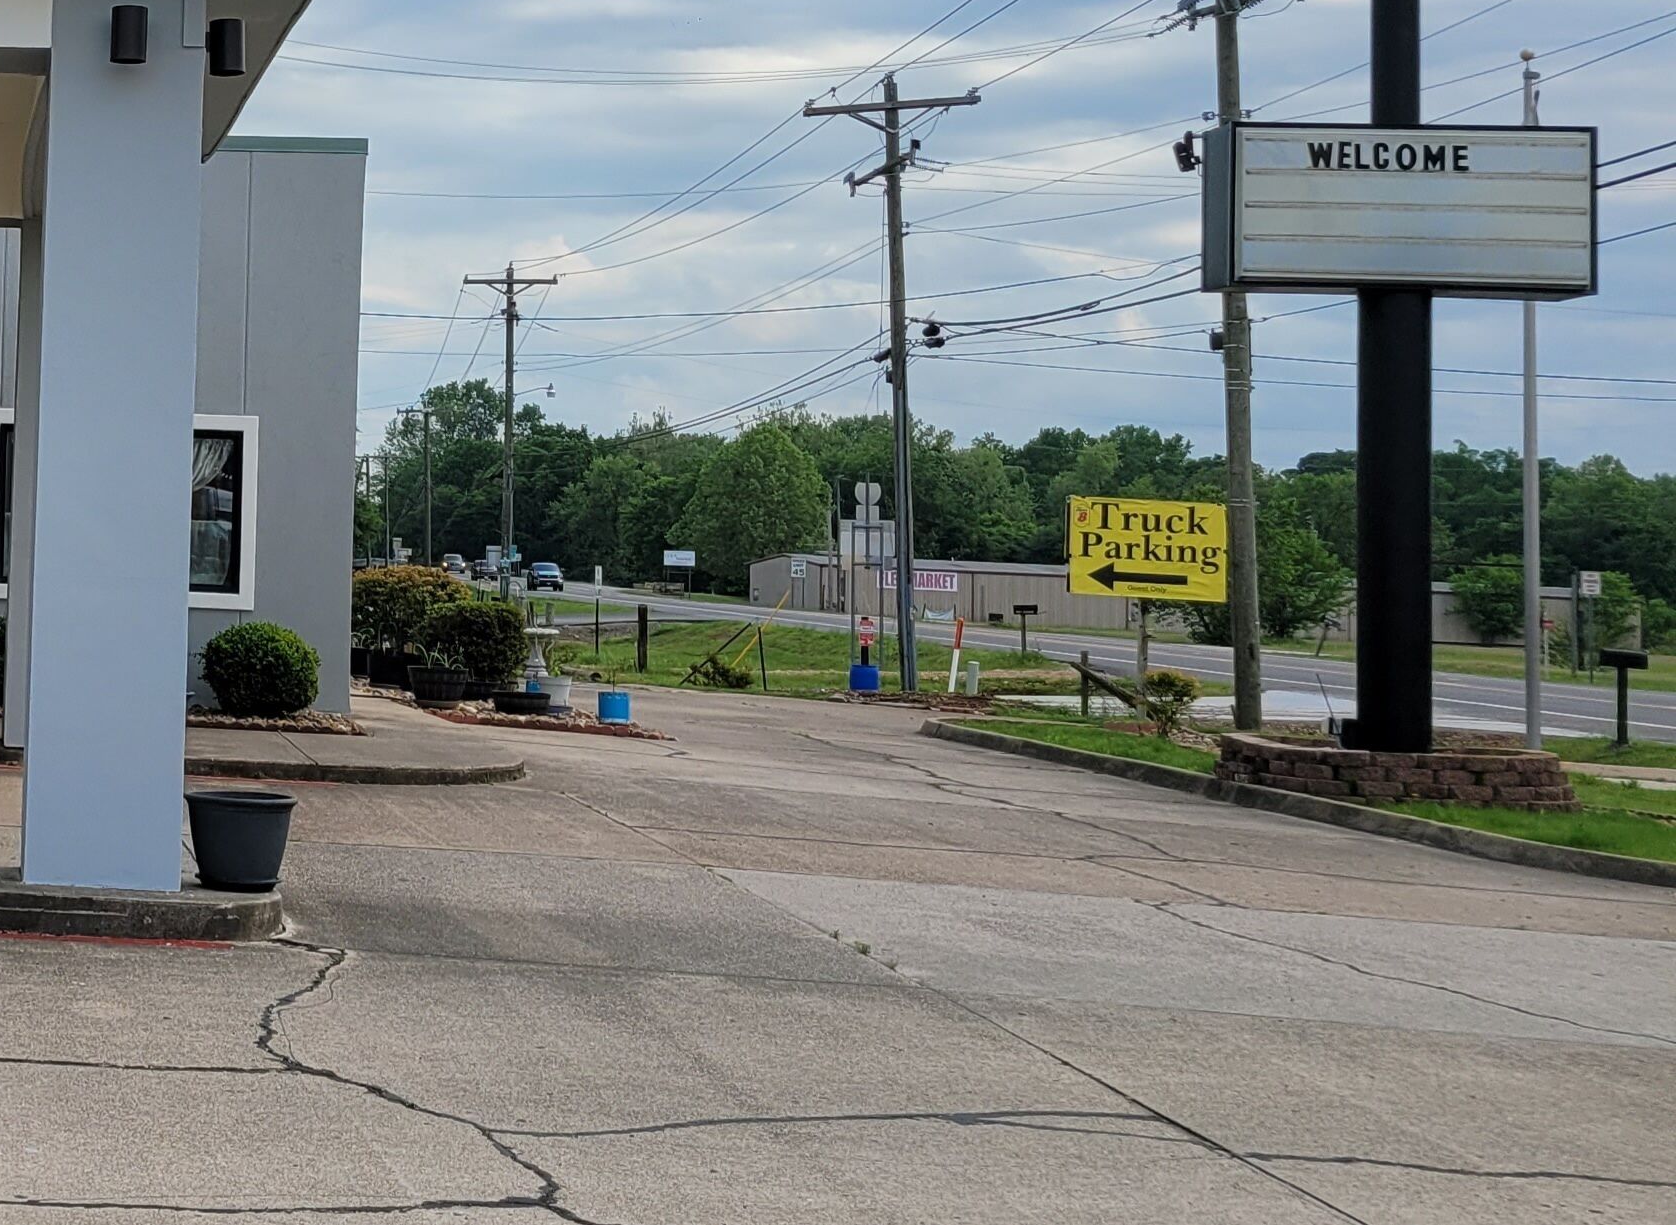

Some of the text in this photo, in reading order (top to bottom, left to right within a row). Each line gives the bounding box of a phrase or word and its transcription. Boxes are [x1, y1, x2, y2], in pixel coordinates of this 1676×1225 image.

[1307, 141, 1469, 171] WELCOME
[1091, 501, 1208, 536] Truck
[1079, 530, 1221, 575] Parking
[792, 568, 805, 576] 45
[1150, 585, 1167, 595] Only
